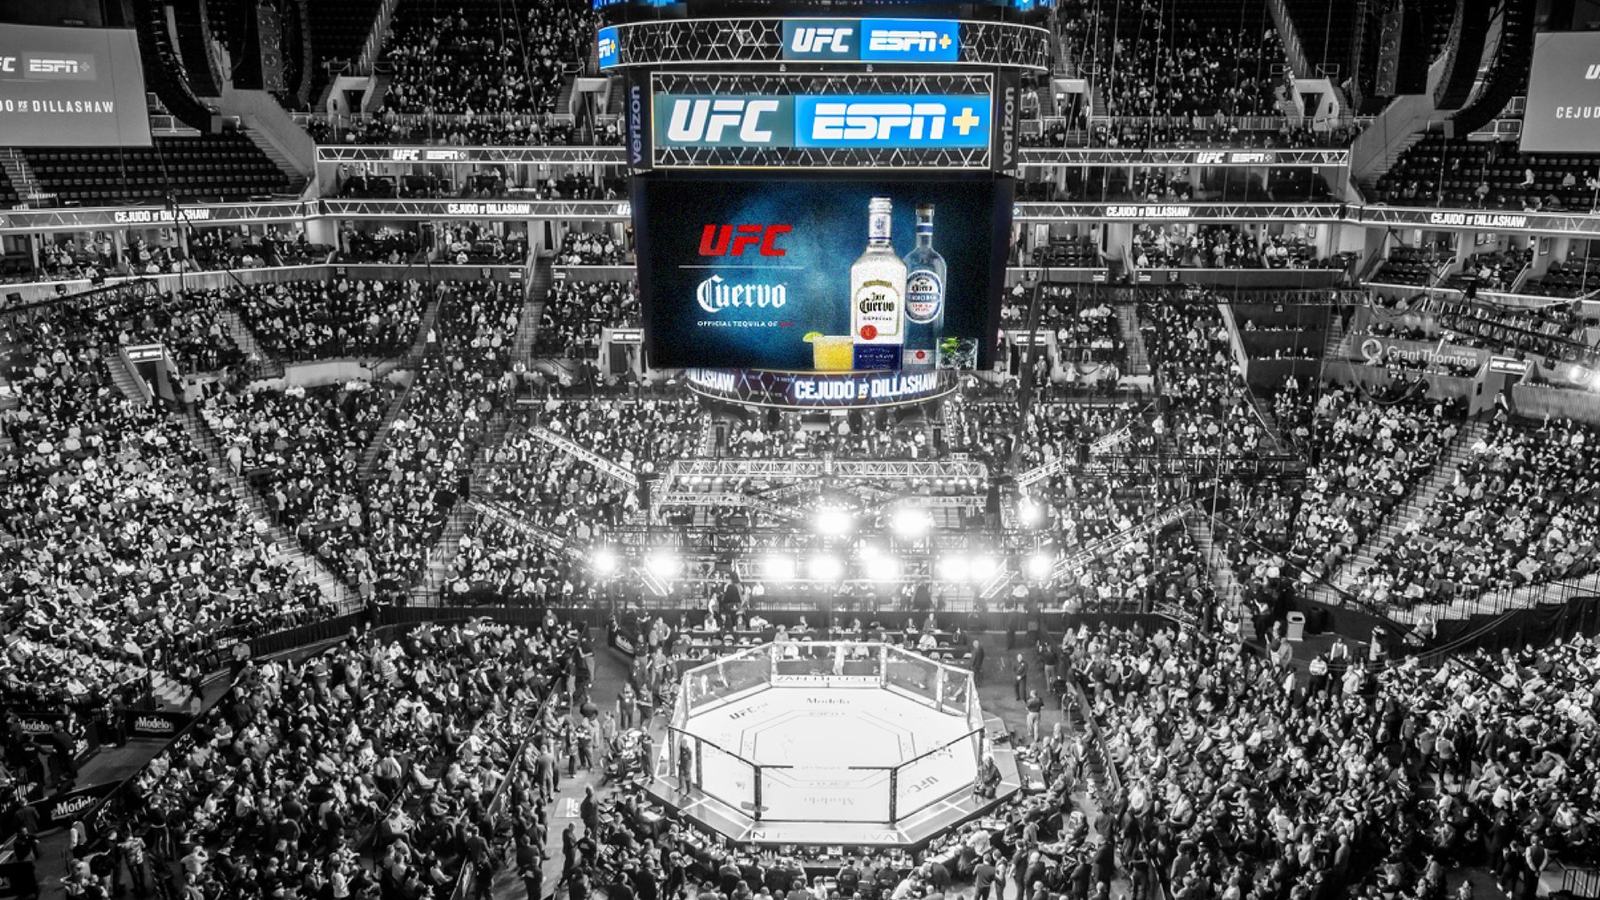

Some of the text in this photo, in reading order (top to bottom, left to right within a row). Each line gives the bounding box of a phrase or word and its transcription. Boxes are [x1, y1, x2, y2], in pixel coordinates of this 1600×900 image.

[791, 28, 853, 53] UFC
[32, 100, 114, 113] DILLASHAW
[630, 86, 642, 164] verizon
[667, 99, 780, 143] UFC
[1002, 86, 1015, 166] verizon
[392, 150, 419, 161] UFC
[1196, 152, 1225, 164] UFC
[114, 211, 150, 223] CEJUDO
[448, 203, 479, 215] CEJUDO
[486, 203, 530, 215] DILLASHAW
[1106, 206, 1137, 218] CEJUDO
[1145, 206, 1191, 218] DILLASHAW
[1430, 212, 1465, 225] CEJUDO
[1473, 214, 1527, 228] DILLASHAW
[698, 224, 793, 257] UFC
[696, 273, 786, 313] Cuervo
[859, 297, 895, 314] Cuervo
[697, 320, 732, 328] OFFICIAL
[733, 320, 767, 328] TEQUILA
[794, 380, 855, 400] CEJUDO
[871, 372, 938, 398] DILLASHAW
[138, 716, 171, 729] Modelo
